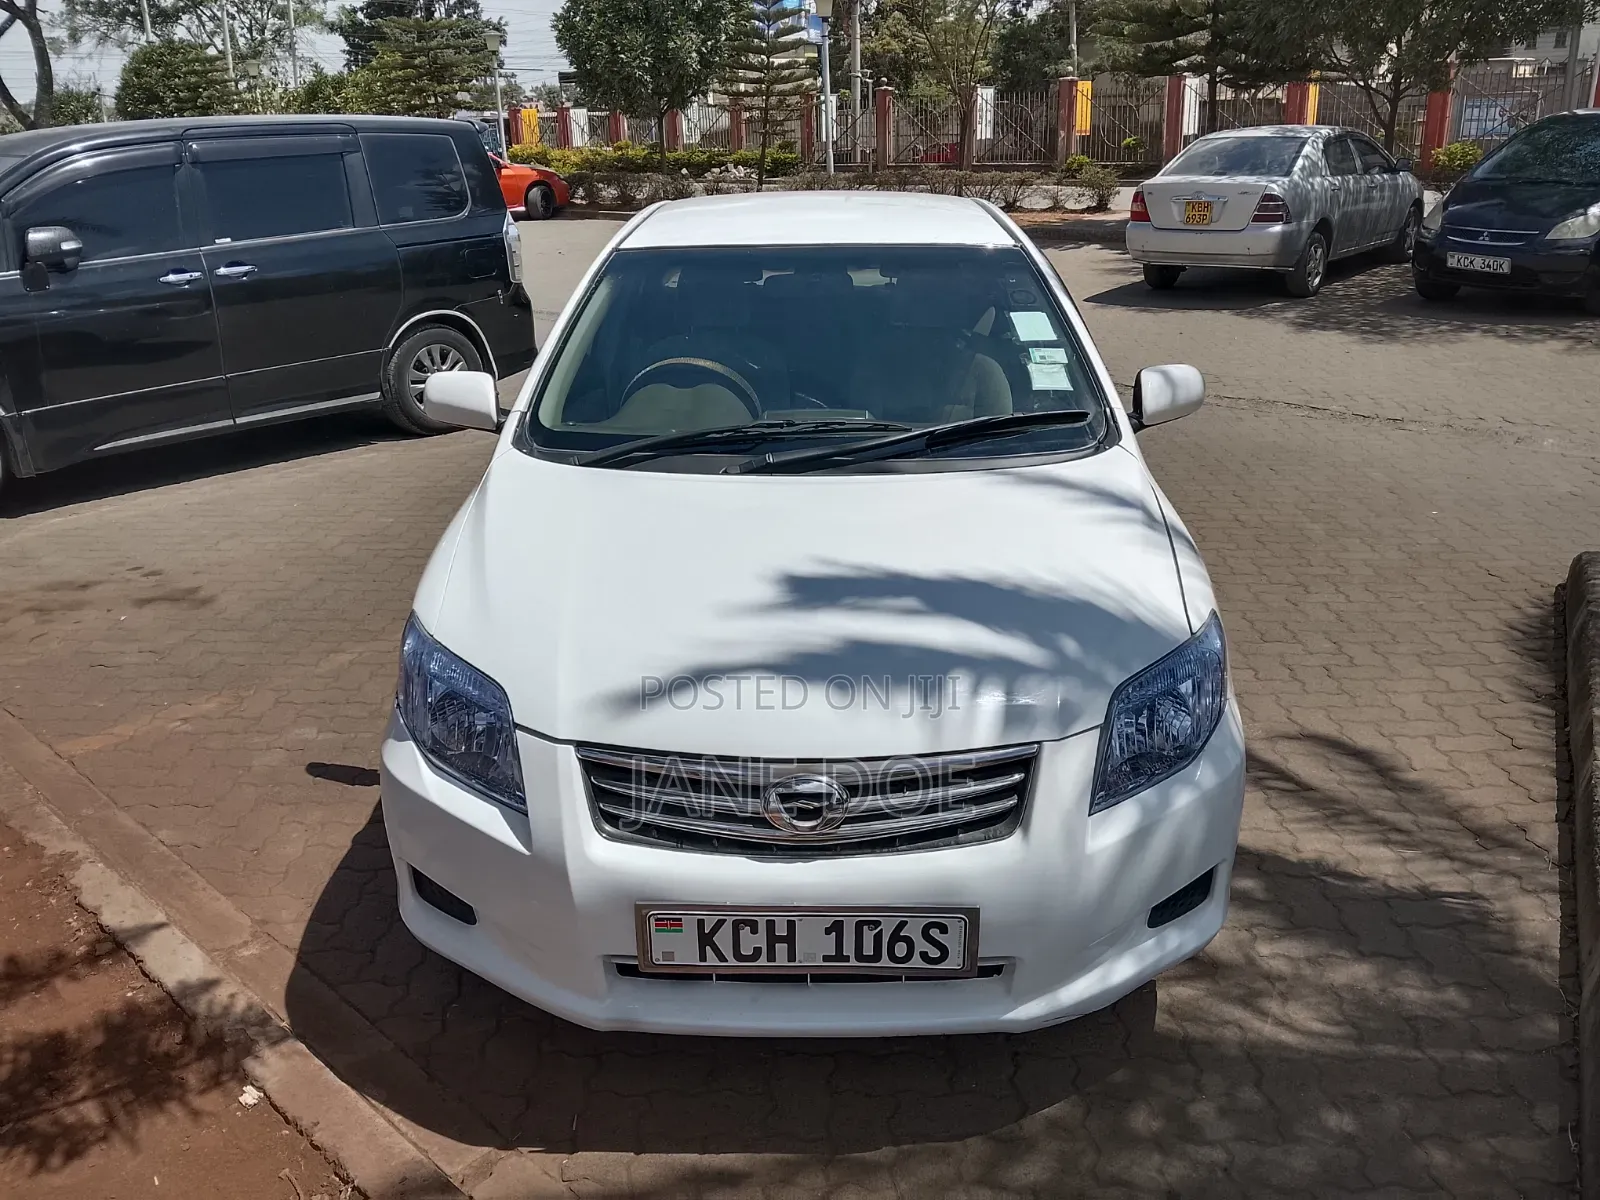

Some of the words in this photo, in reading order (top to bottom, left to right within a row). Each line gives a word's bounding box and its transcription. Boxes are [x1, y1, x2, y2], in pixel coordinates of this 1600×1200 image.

[1191, 202, 1209, 213] KBH
[1185, 213, 1208, 224] 693P
[1456, 255, 1476, 268] KCK
[1480, 258, 1505, 271] 340K
[697, 918, 796, 963] KCH
[822, 919, 950, 965] 106S
